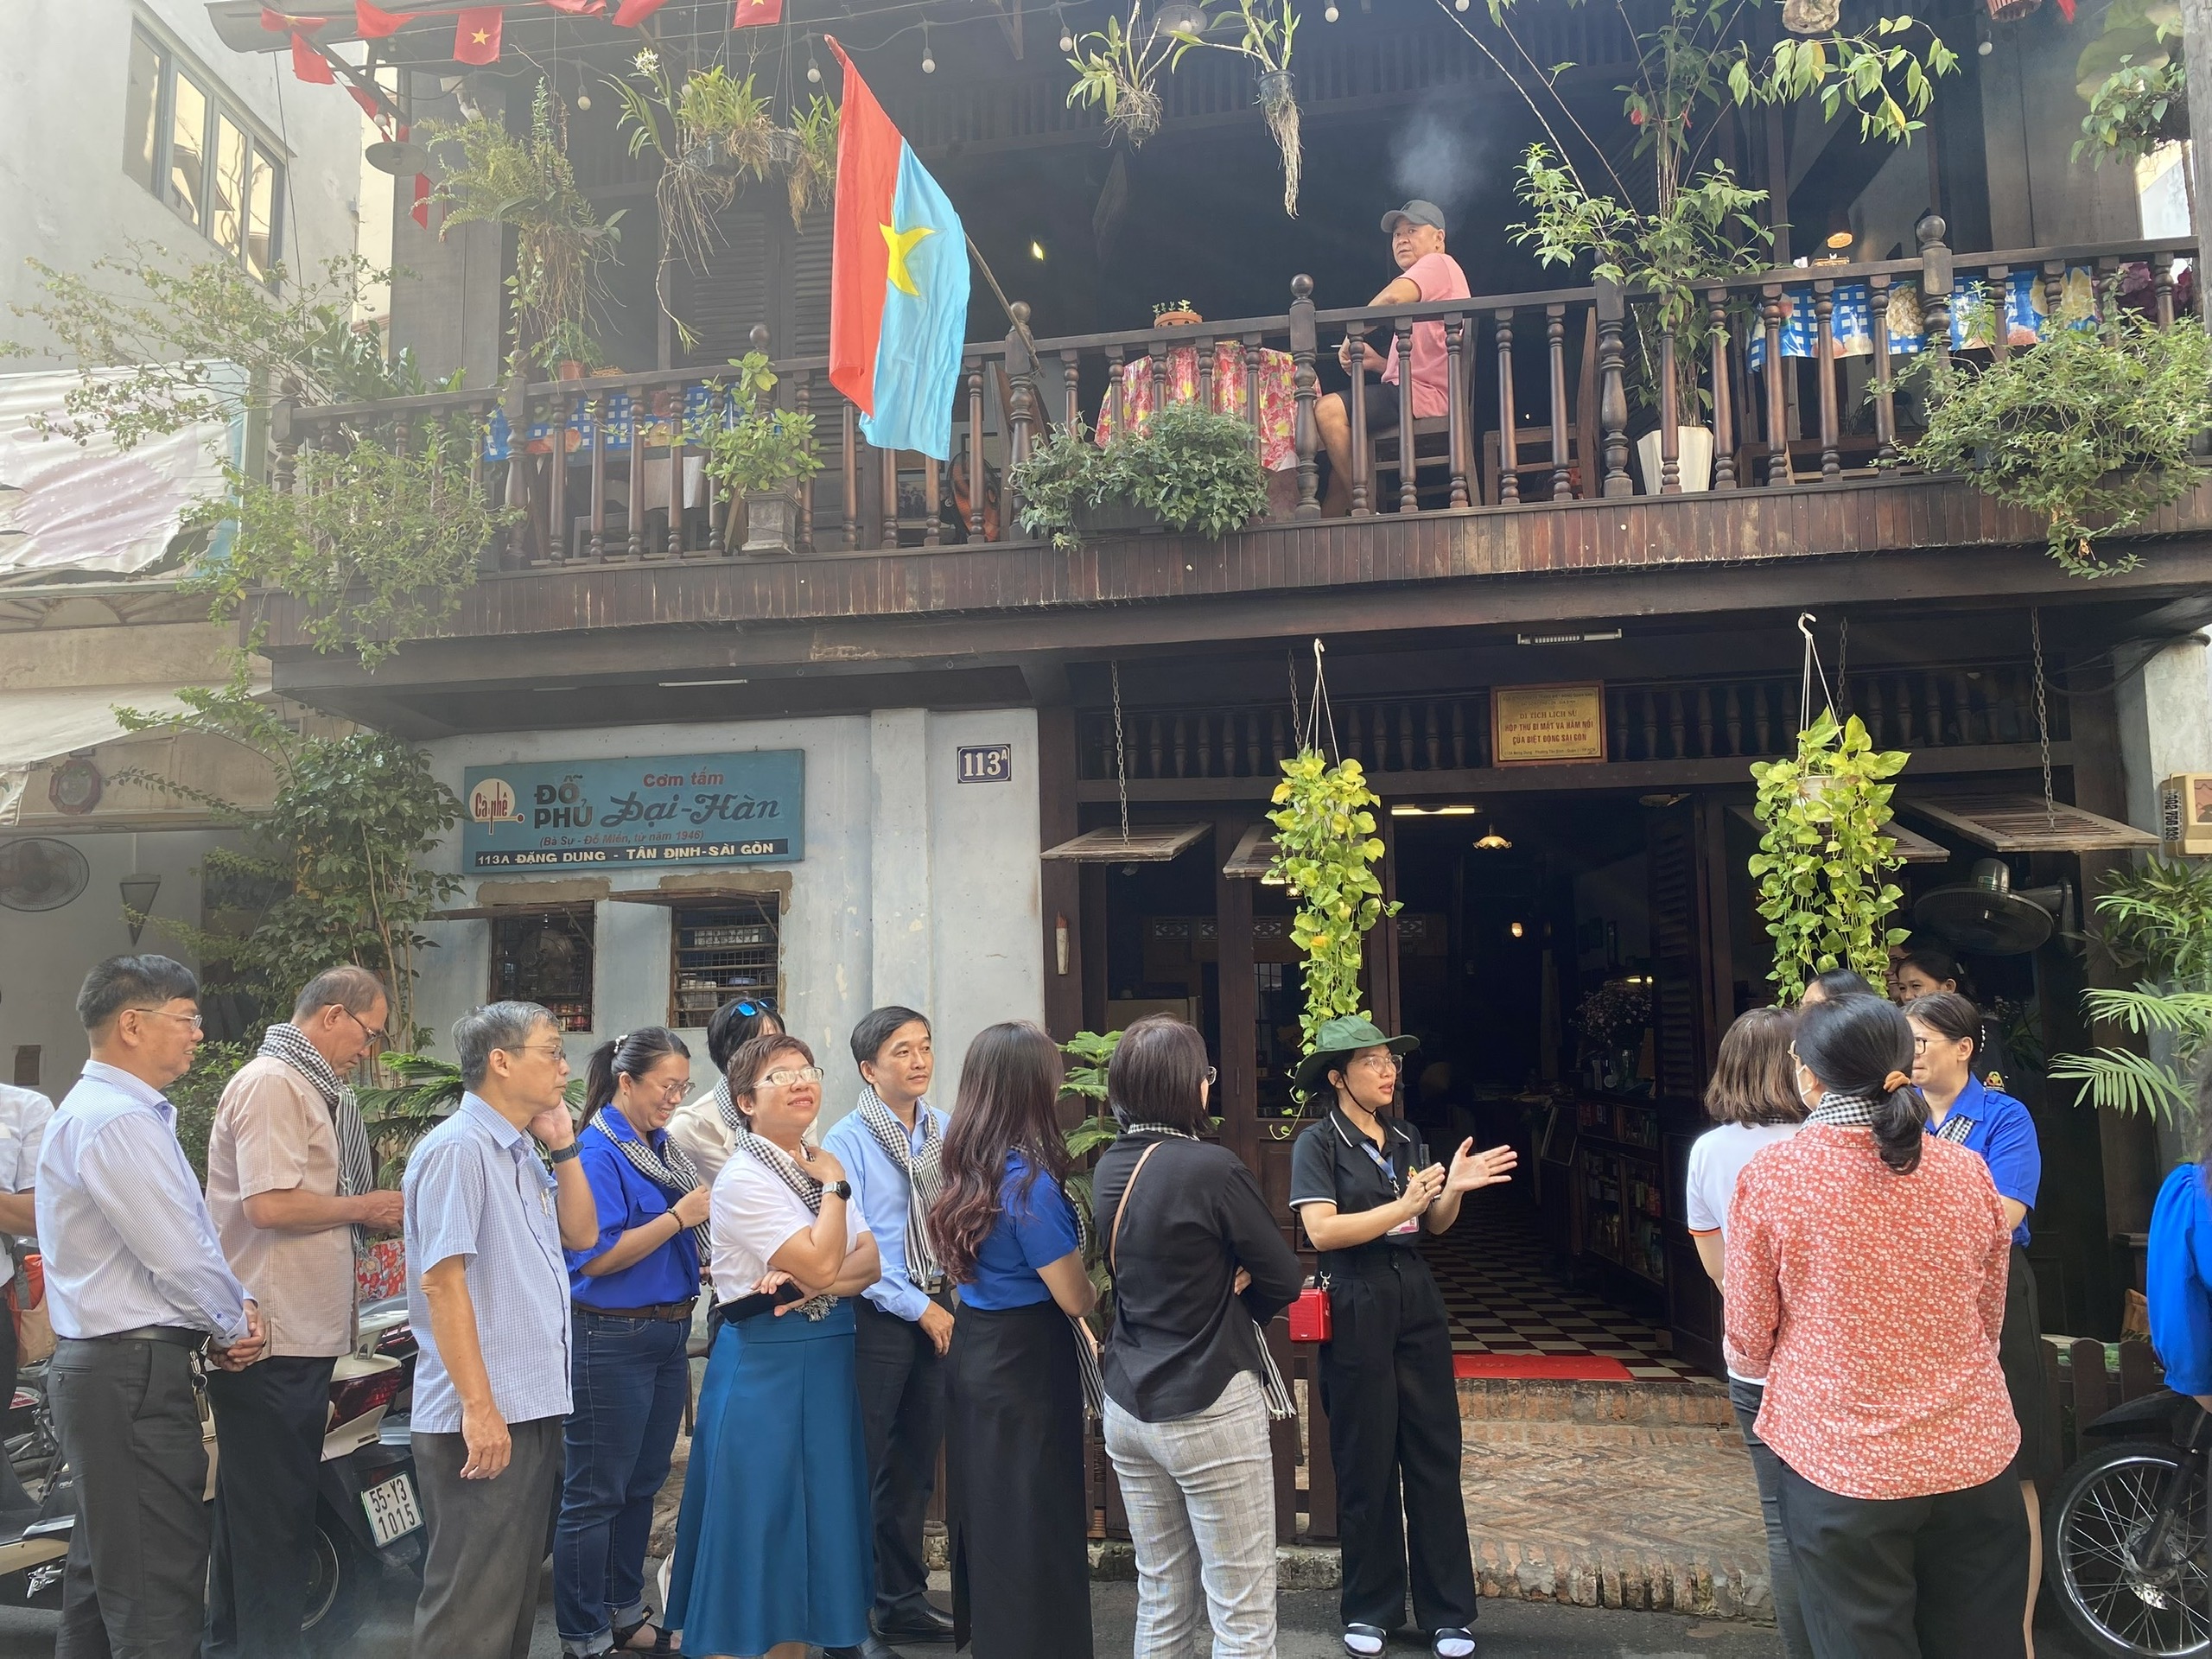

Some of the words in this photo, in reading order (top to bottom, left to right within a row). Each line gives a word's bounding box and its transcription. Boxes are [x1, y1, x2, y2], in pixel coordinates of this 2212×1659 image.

[643, 773, 684, 787] Cơm
[690, 766, 724, 785] tấm
[534, 798, 593, 830] PHỦ
[676, 830, 704, 842] 1946)
[478, 855, 510, 865] 113A
[514, 851, 557, 864] ĐẶNG
[563, 849, 606, 863] DUNG
[626, 846, 657, 860] TÂN
[740, 841, 773, 855] GÒN
[378, 1503, 415, 1540] 1015
